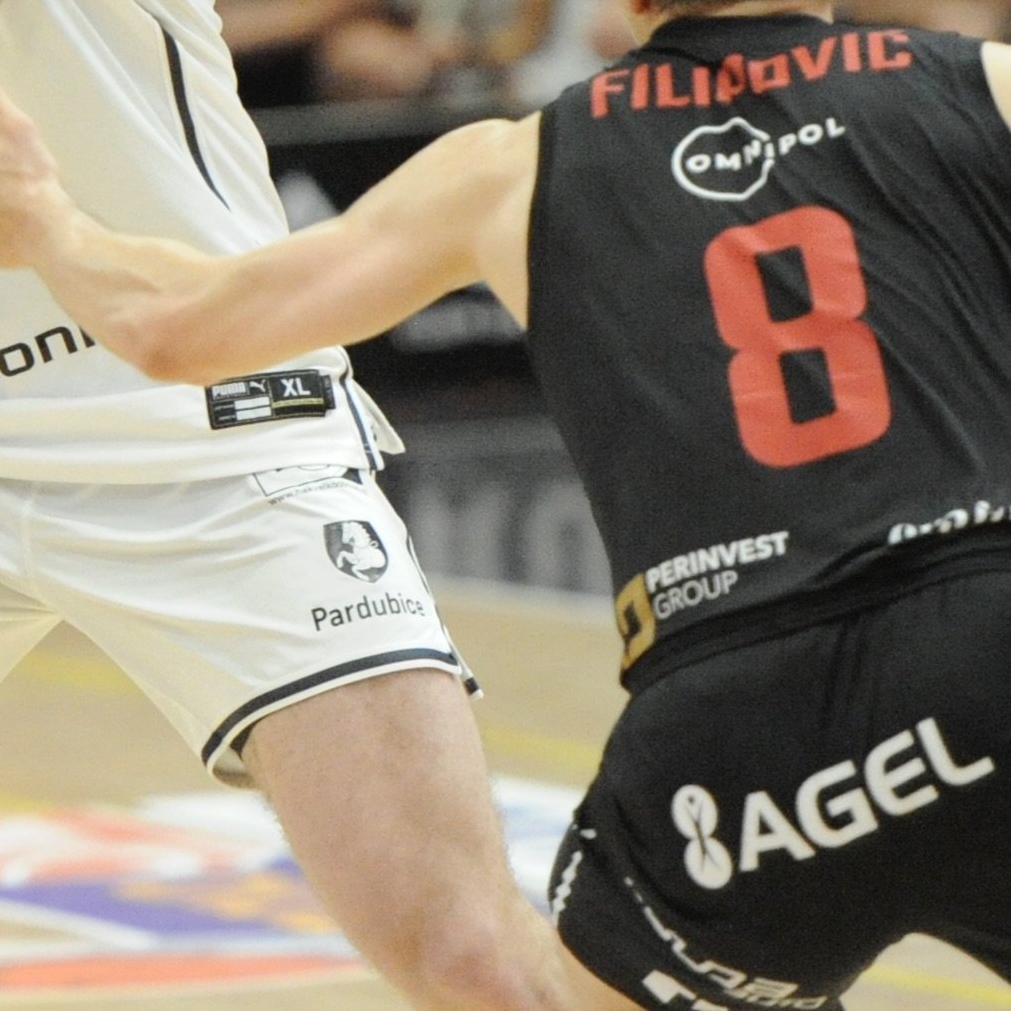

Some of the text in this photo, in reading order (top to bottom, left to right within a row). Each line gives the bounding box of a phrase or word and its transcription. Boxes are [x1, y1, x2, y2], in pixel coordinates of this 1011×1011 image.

[591, 29, 913, 119] FILIPOVIC
[686, 118, 846, 174] OMNIPOL
[703, 205, 892, 469] 8
[280, 377, 311, 398] XL
[645, 531, 789, 593] PERINVEST
[311, 592, 425, 632] Pardubice
[653, 570, 738, 619] GROUP
[739, 717, 995, 872] AGEL
